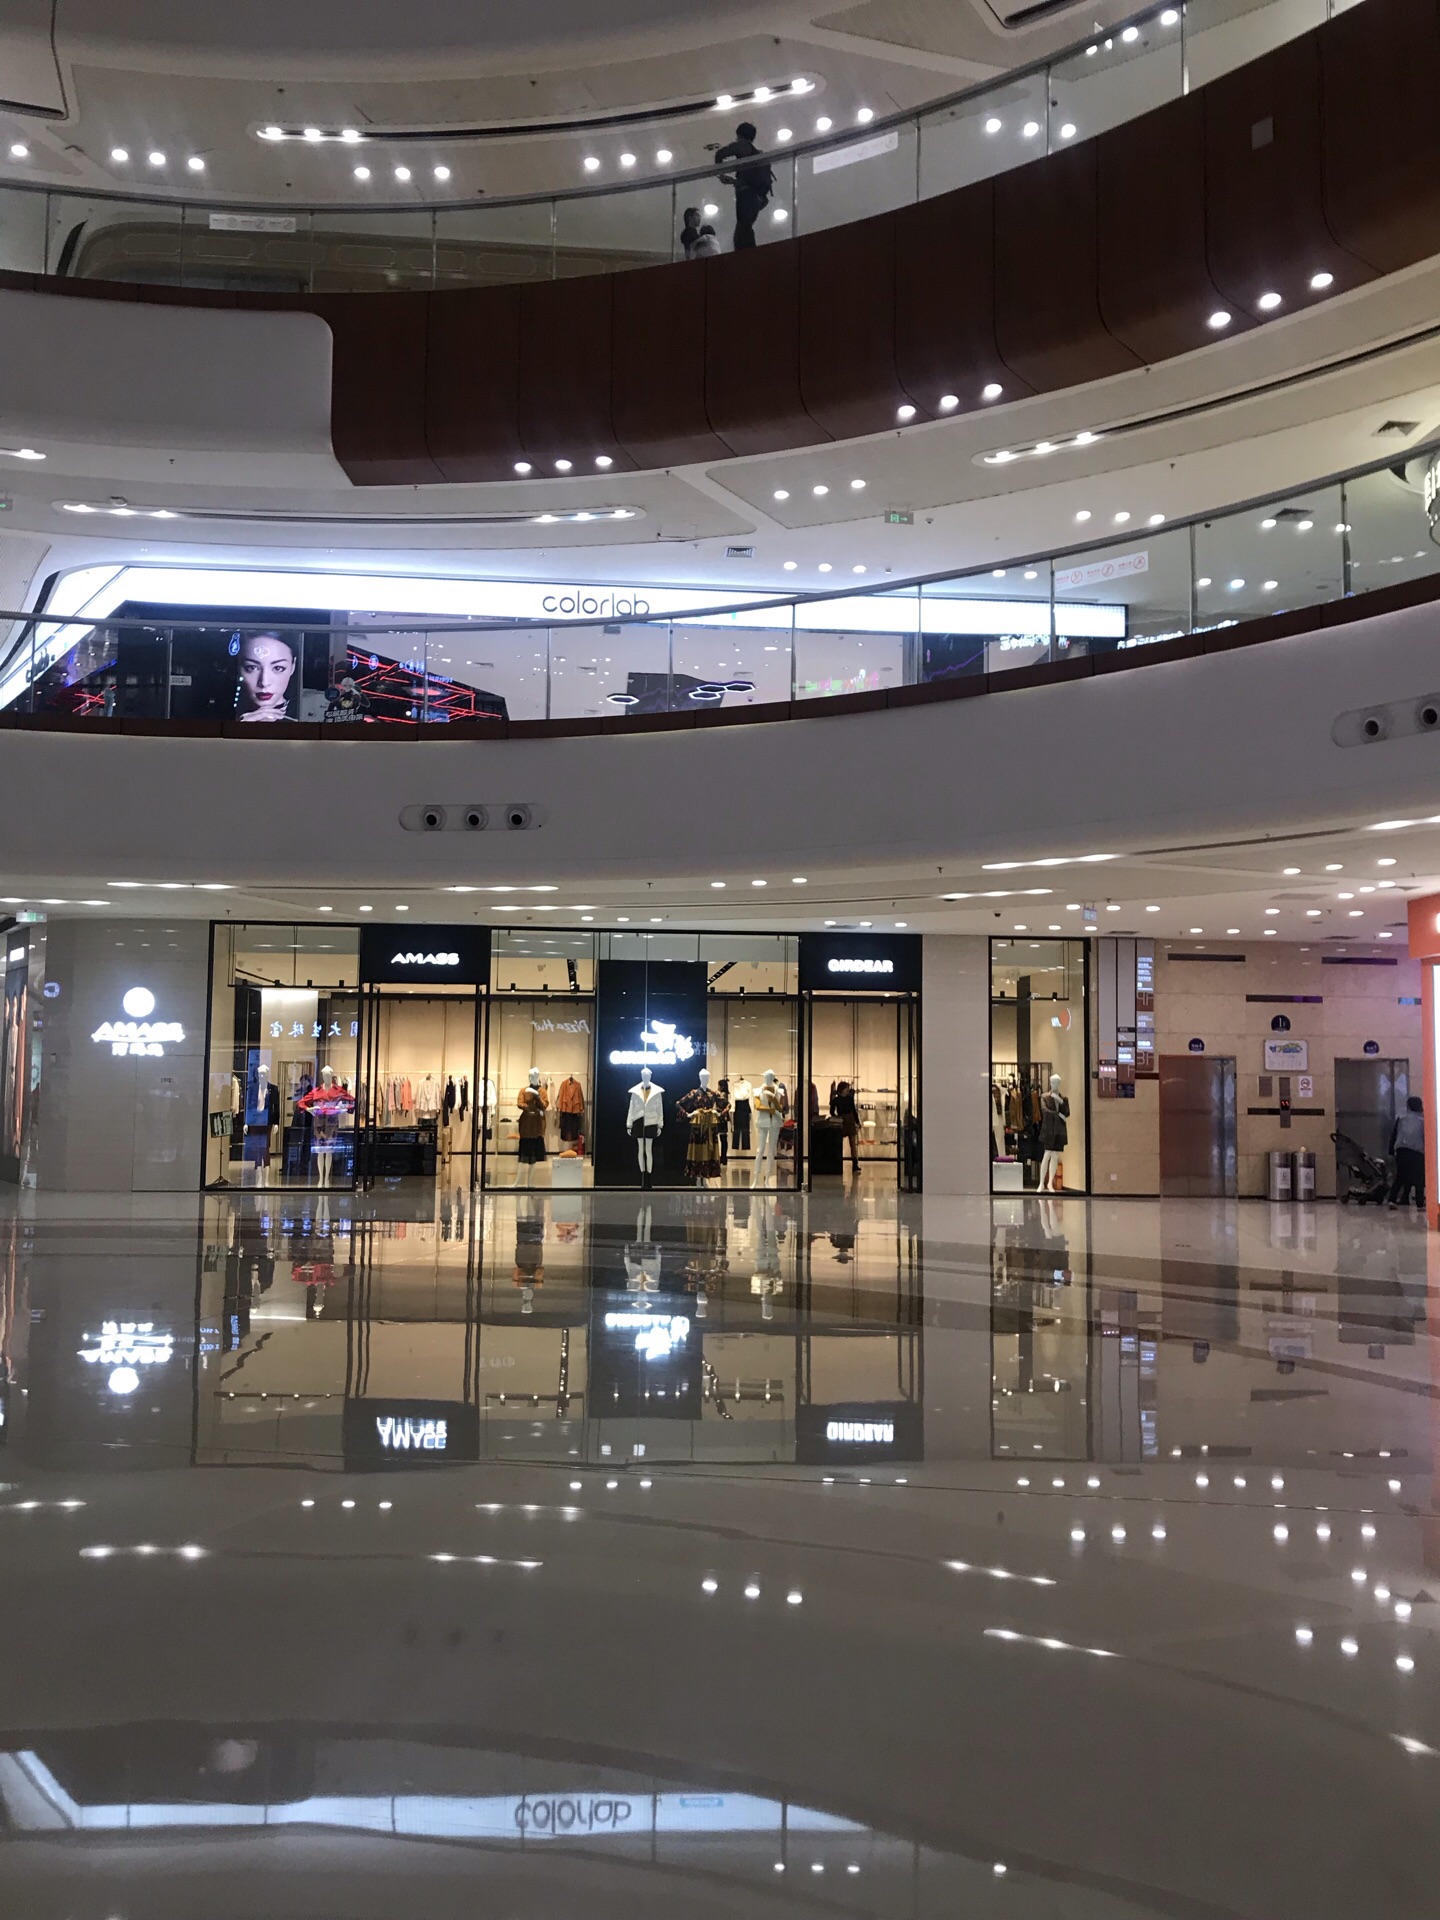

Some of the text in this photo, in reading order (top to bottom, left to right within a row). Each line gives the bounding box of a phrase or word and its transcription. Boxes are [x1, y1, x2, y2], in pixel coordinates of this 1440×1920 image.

[542, 590, 649, 616] colorlab
[391, 952, 460, 965] AMASS
[828, 958, 893, 973] GIRDEAR
